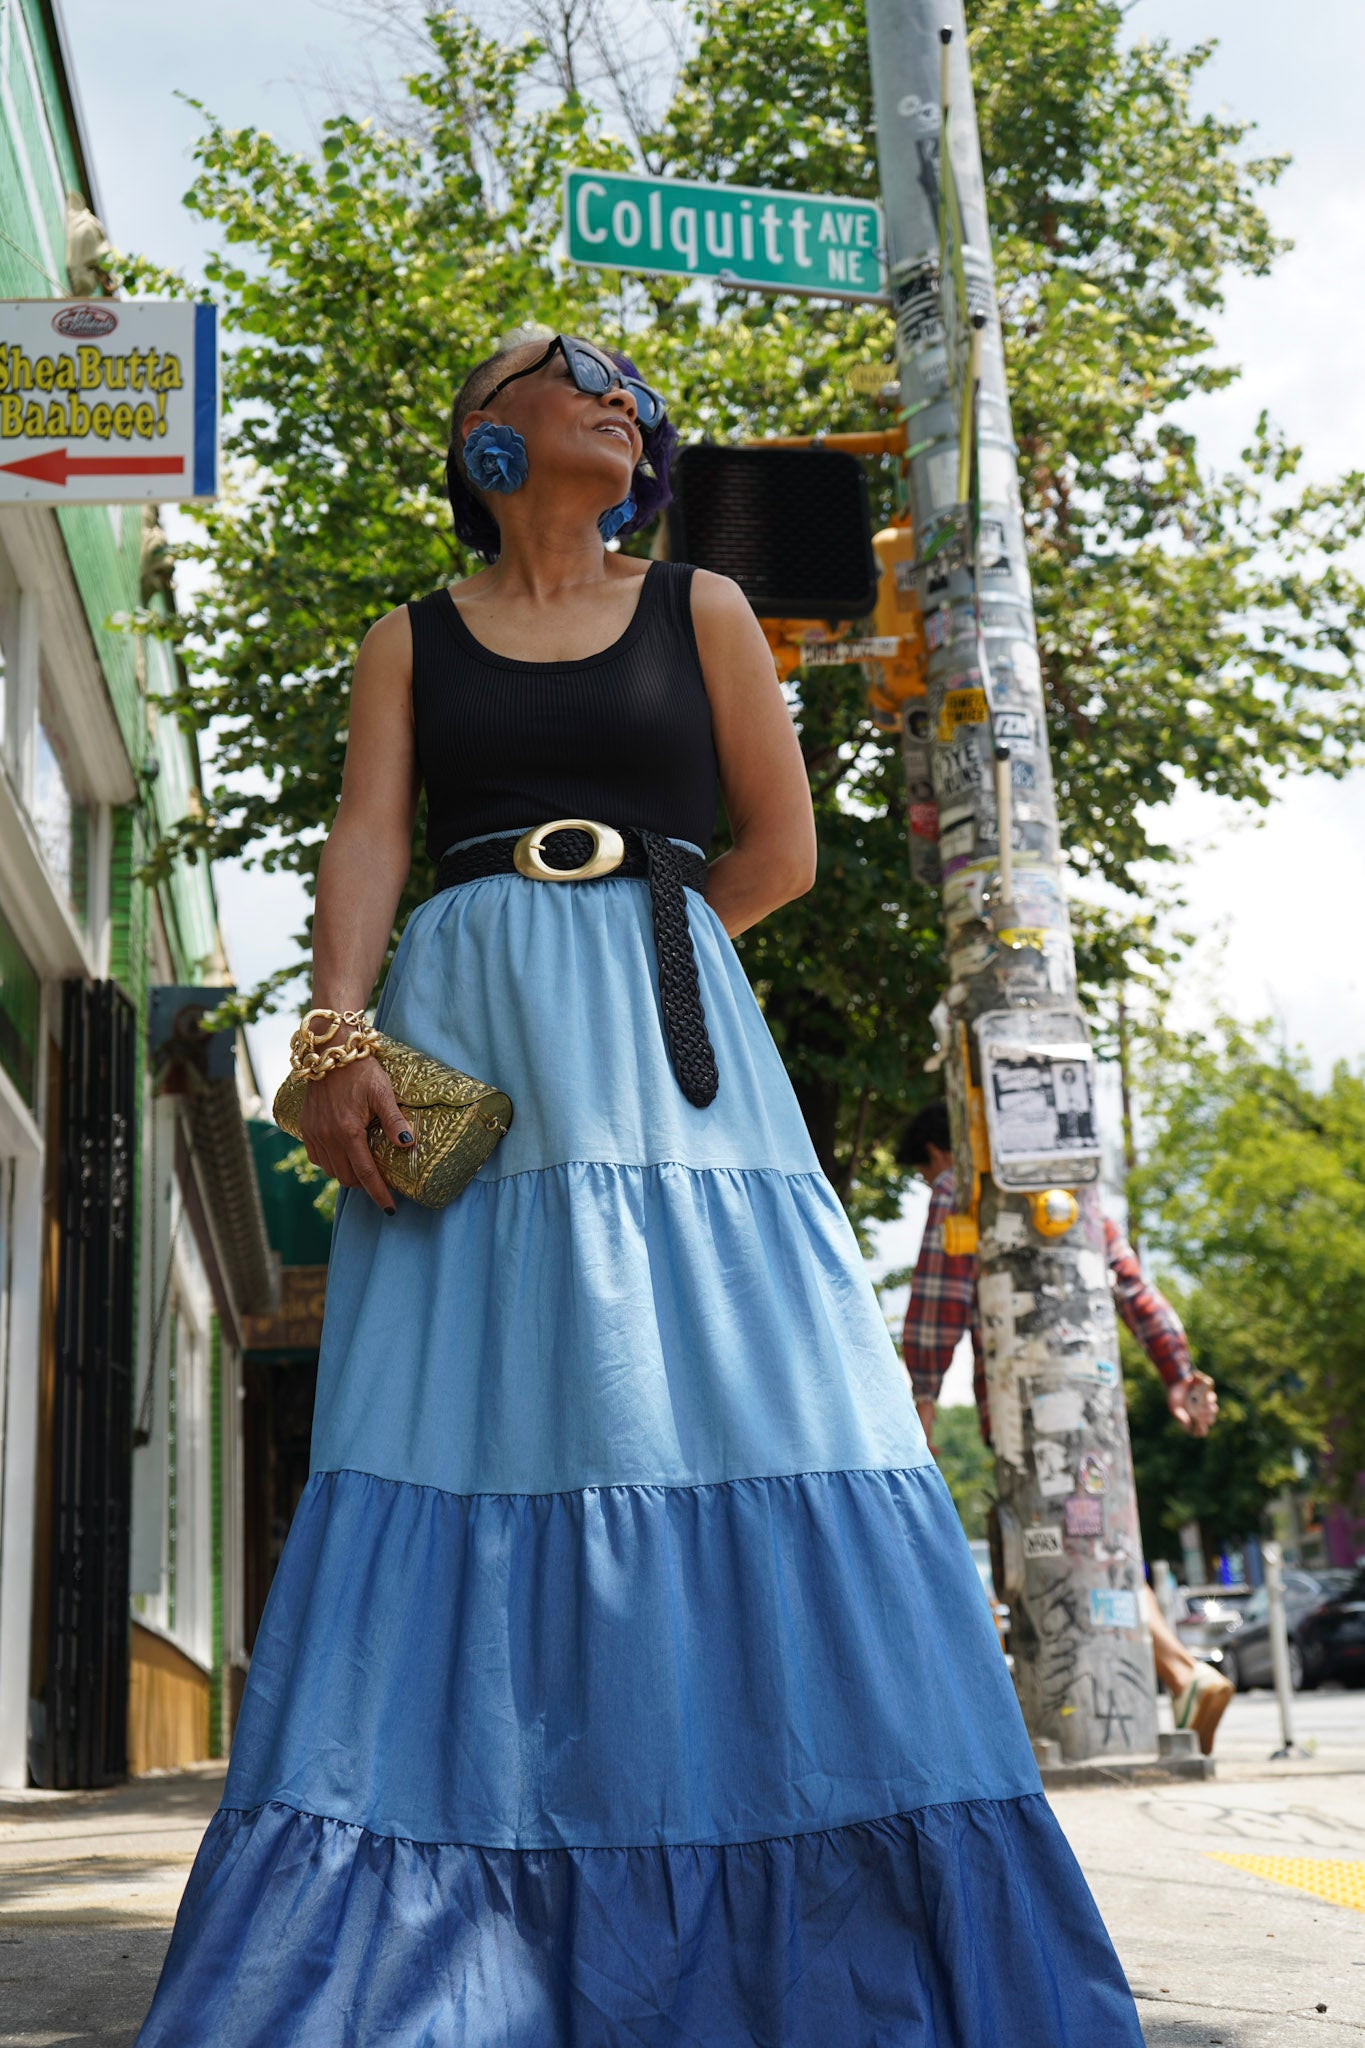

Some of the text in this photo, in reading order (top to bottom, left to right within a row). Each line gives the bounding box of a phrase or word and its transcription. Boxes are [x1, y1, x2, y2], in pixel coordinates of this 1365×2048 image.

[576, 181, 872, 270] Colquitt AVE
[828, 249, 864, 283] NE
[0, 390, 168, 440] Baabeee!
